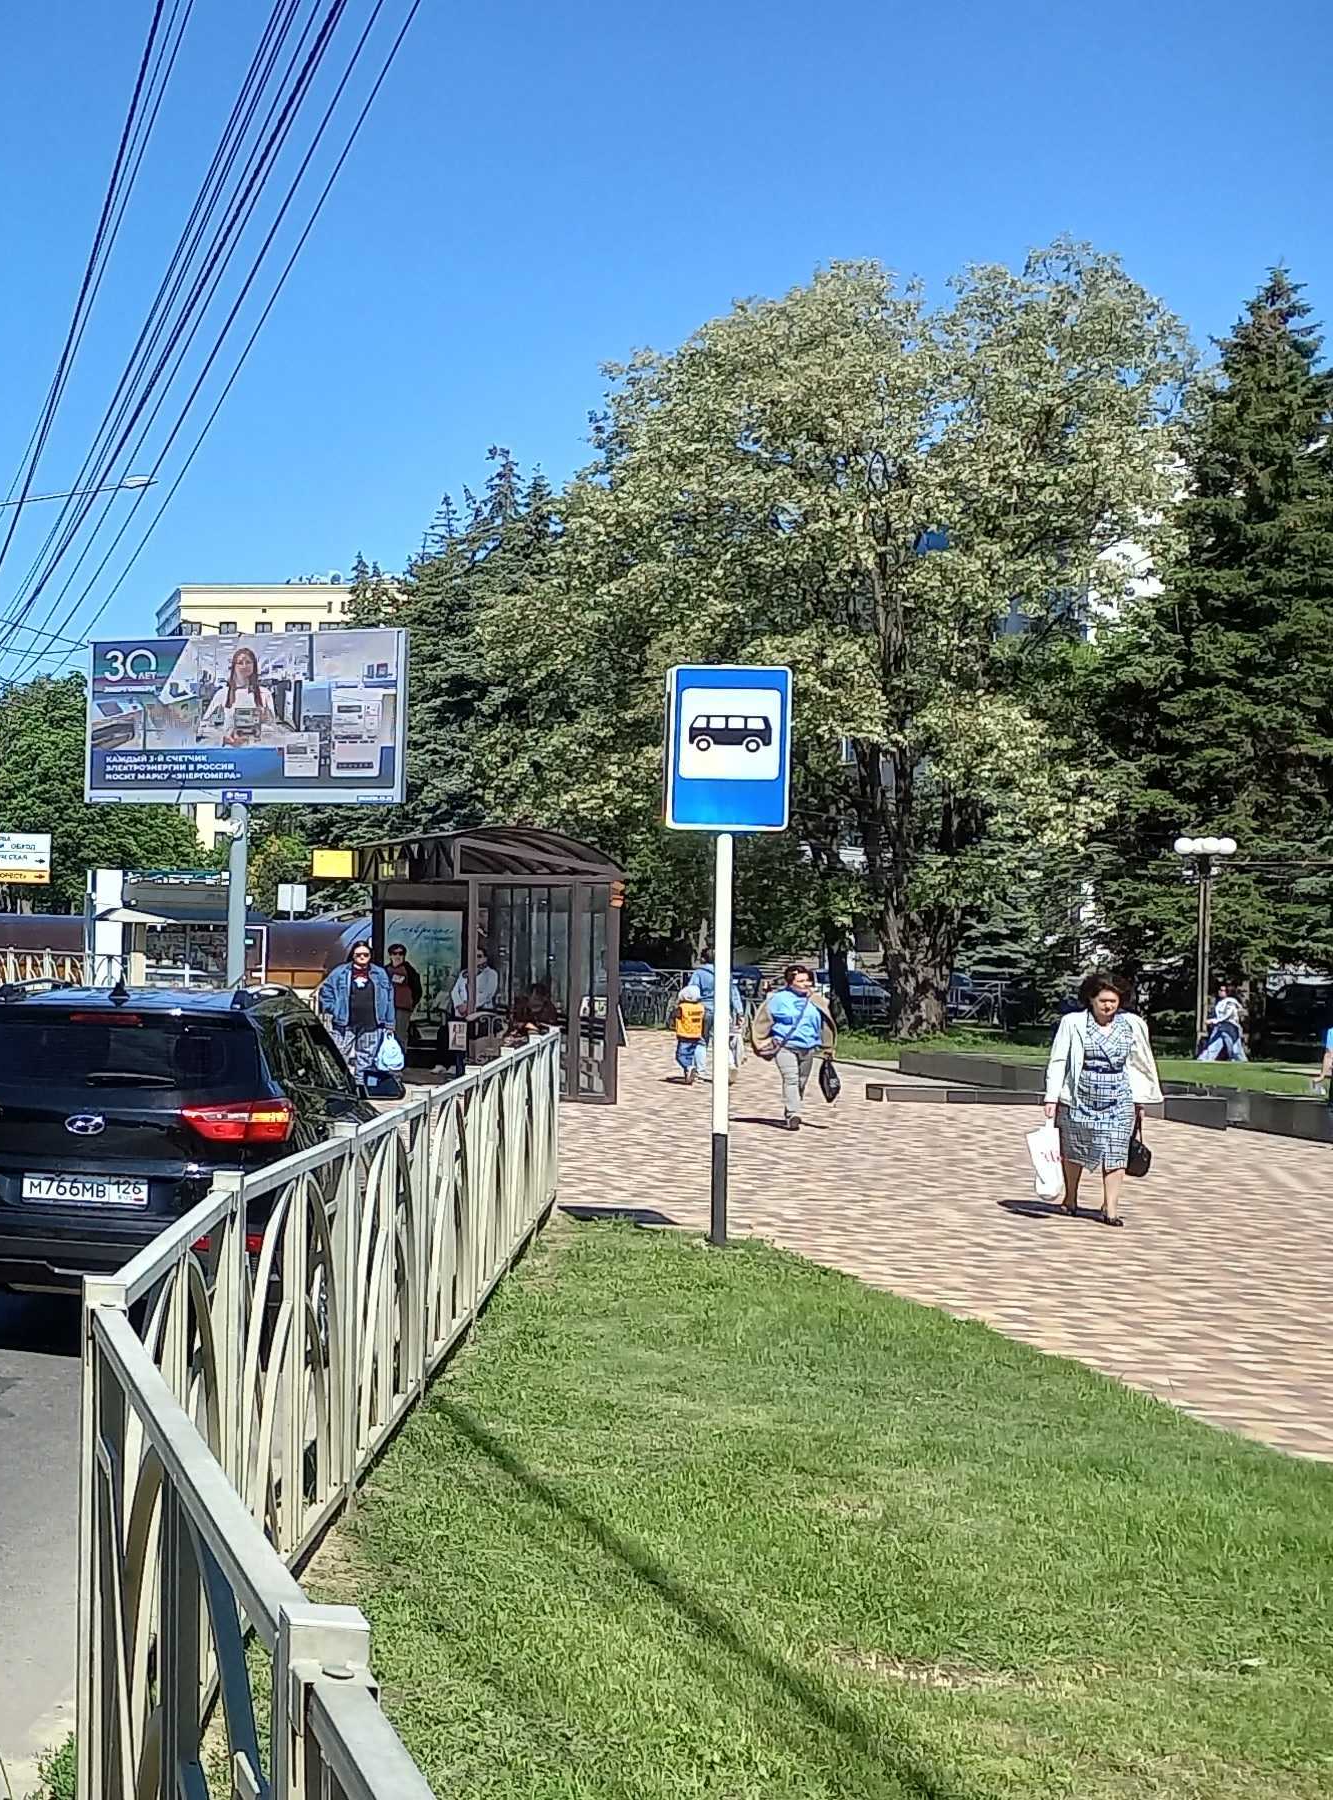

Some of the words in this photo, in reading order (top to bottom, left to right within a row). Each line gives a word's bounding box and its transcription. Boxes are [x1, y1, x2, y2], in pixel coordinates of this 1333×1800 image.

[105, 754, 147, 763] КАЖДЫЙ
[166, 754, 208, 762] СЧЕТЧИК
[105, 763, 186, 771] ЭЛЕКТРОЭНЕРГИИ
[197, 763, 235, 771] РОССИИ
[29, 1178, 106, 1198] М766МВ
[116, 1180, 141, 1195] 126
